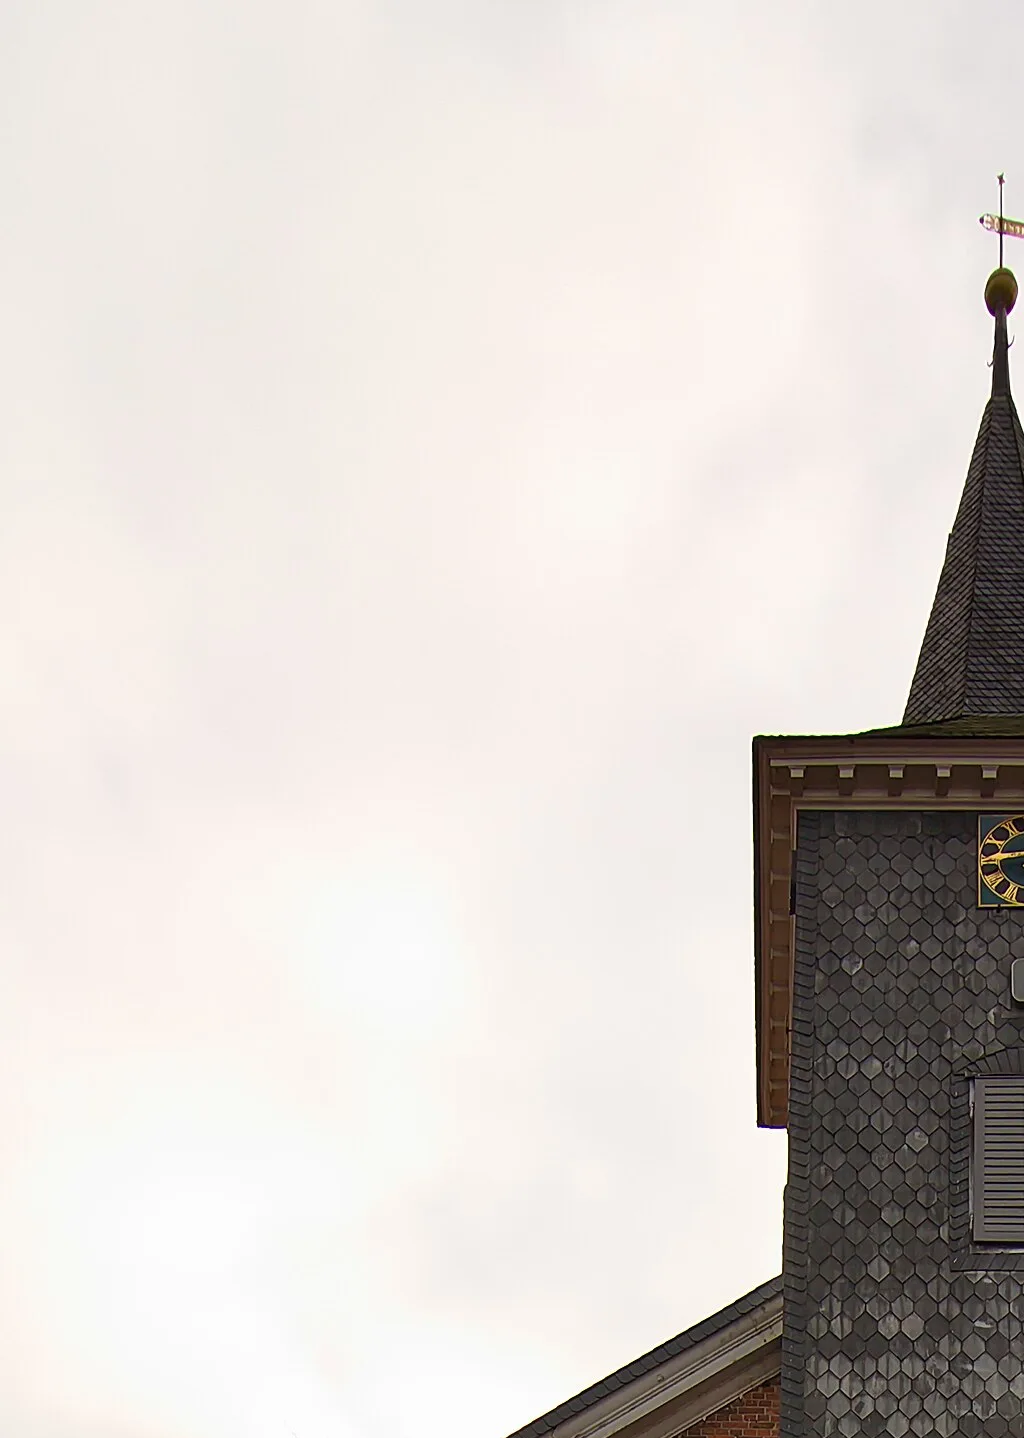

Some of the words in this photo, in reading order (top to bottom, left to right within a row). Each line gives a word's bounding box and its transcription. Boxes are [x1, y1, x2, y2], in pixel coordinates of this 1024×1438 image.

[1001, 820, 1021, 837] XI
[985, 834, 1005, 849] X
[984, 870, 1005, 890] VIII
[1002, 882, 1019, 903] VII
